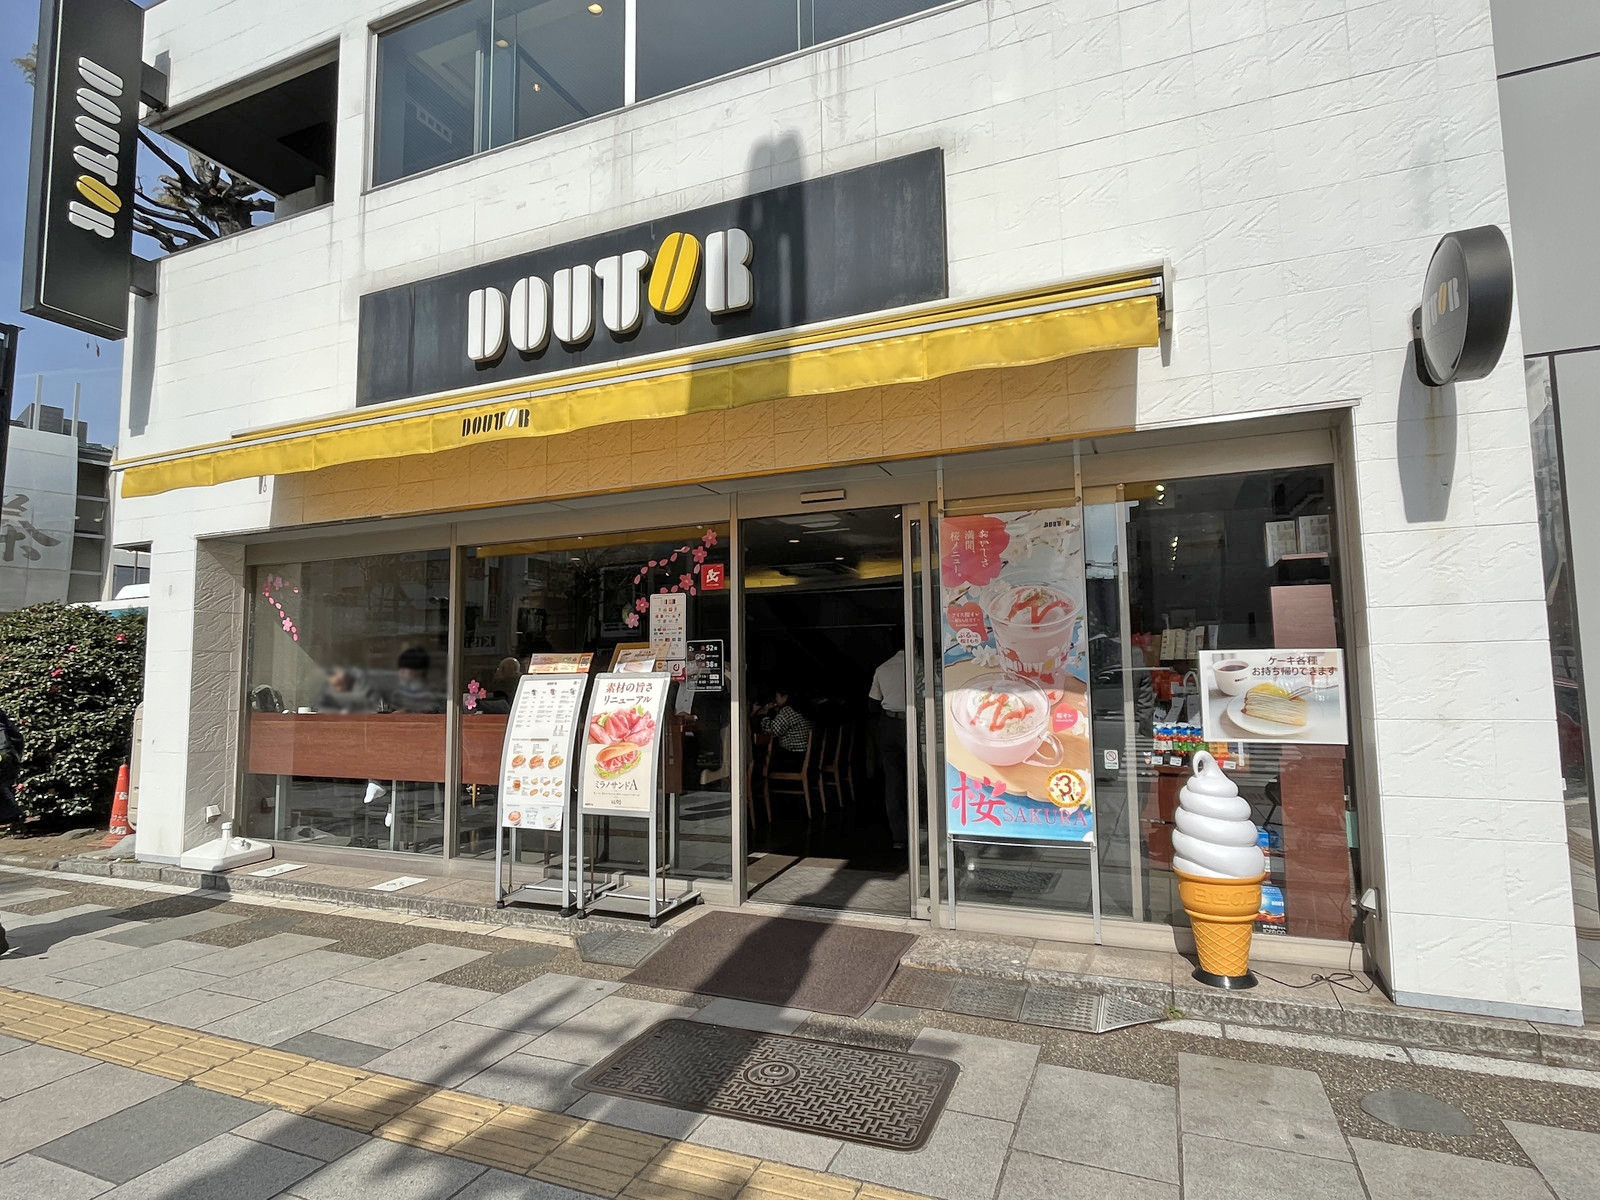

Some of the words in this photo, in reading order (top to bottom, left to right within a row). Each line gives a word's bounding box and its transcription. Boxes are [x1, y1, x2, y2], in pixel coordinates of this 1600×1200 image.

[68, 56, 124, 239] DOUTOR
[467, 227, 754, 362] DOUTOR
[462, 407, 530, 437] DOUTOR
[979, 529, 992, 567] おいしさ
[1268, 655, 1319, 666] ケーキ各種
[1251, 666, 1337, 676] お持ち帰りできます
[606, 681, 653, 693] 素材の旨さ
[604, 695, 653, 705] リニューアル
[594, 778, 638, 791] ミラノサンドA
[951, 771, 1007, 827] 桜
[1003, 807, 1088, 827] SAKURA
[754, 1076, 779, 1084] NTT
